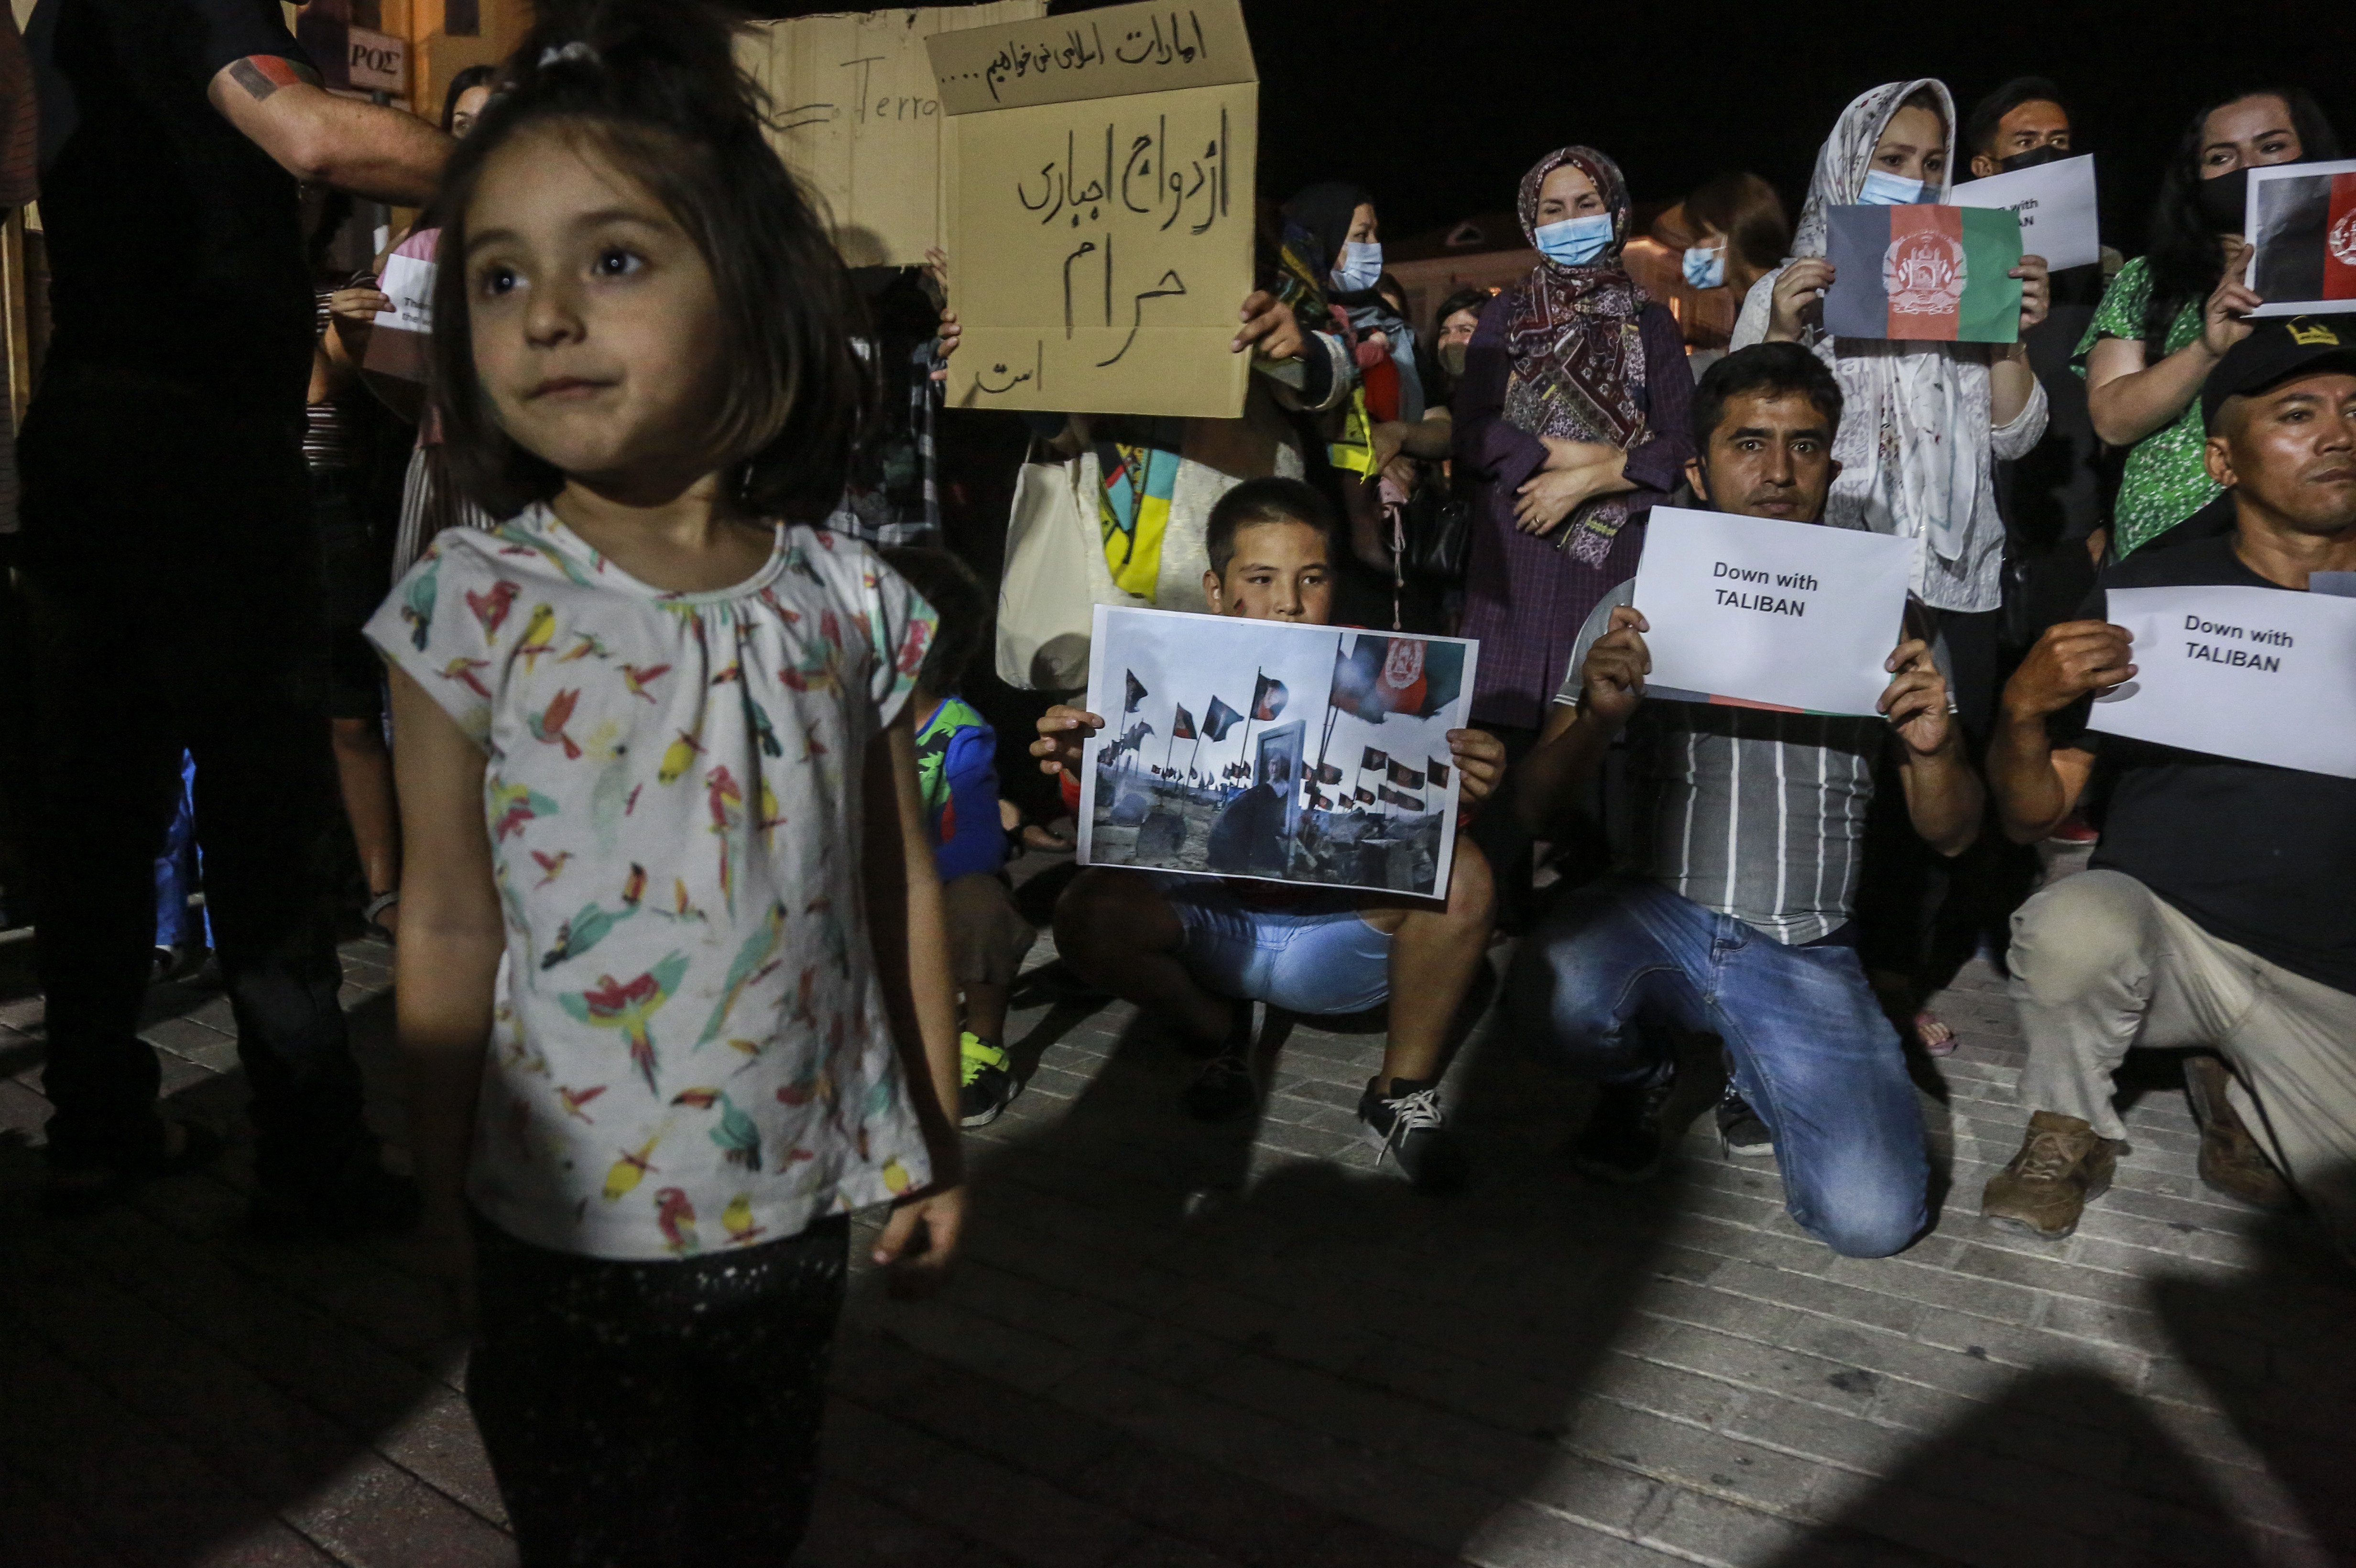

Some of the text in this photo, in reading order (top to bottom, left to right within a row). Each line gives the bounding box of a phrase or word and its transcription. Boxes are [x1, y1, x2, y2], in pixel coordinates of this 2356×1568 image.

[1115, 10, 1207, 65] امارات
[1018, 107, 1228, 235] ازدواج اجباری
[1063, 232, 1187, 367] حرام
[975, 340, 1043, 394] است
[1713, 561, 1818, 591] Down with
[1715, 588, 1806, 617] TALIBAN
[2184, 614, 2294, 648] Down with
[2185, 641, 2280, 673] TALIBAN
